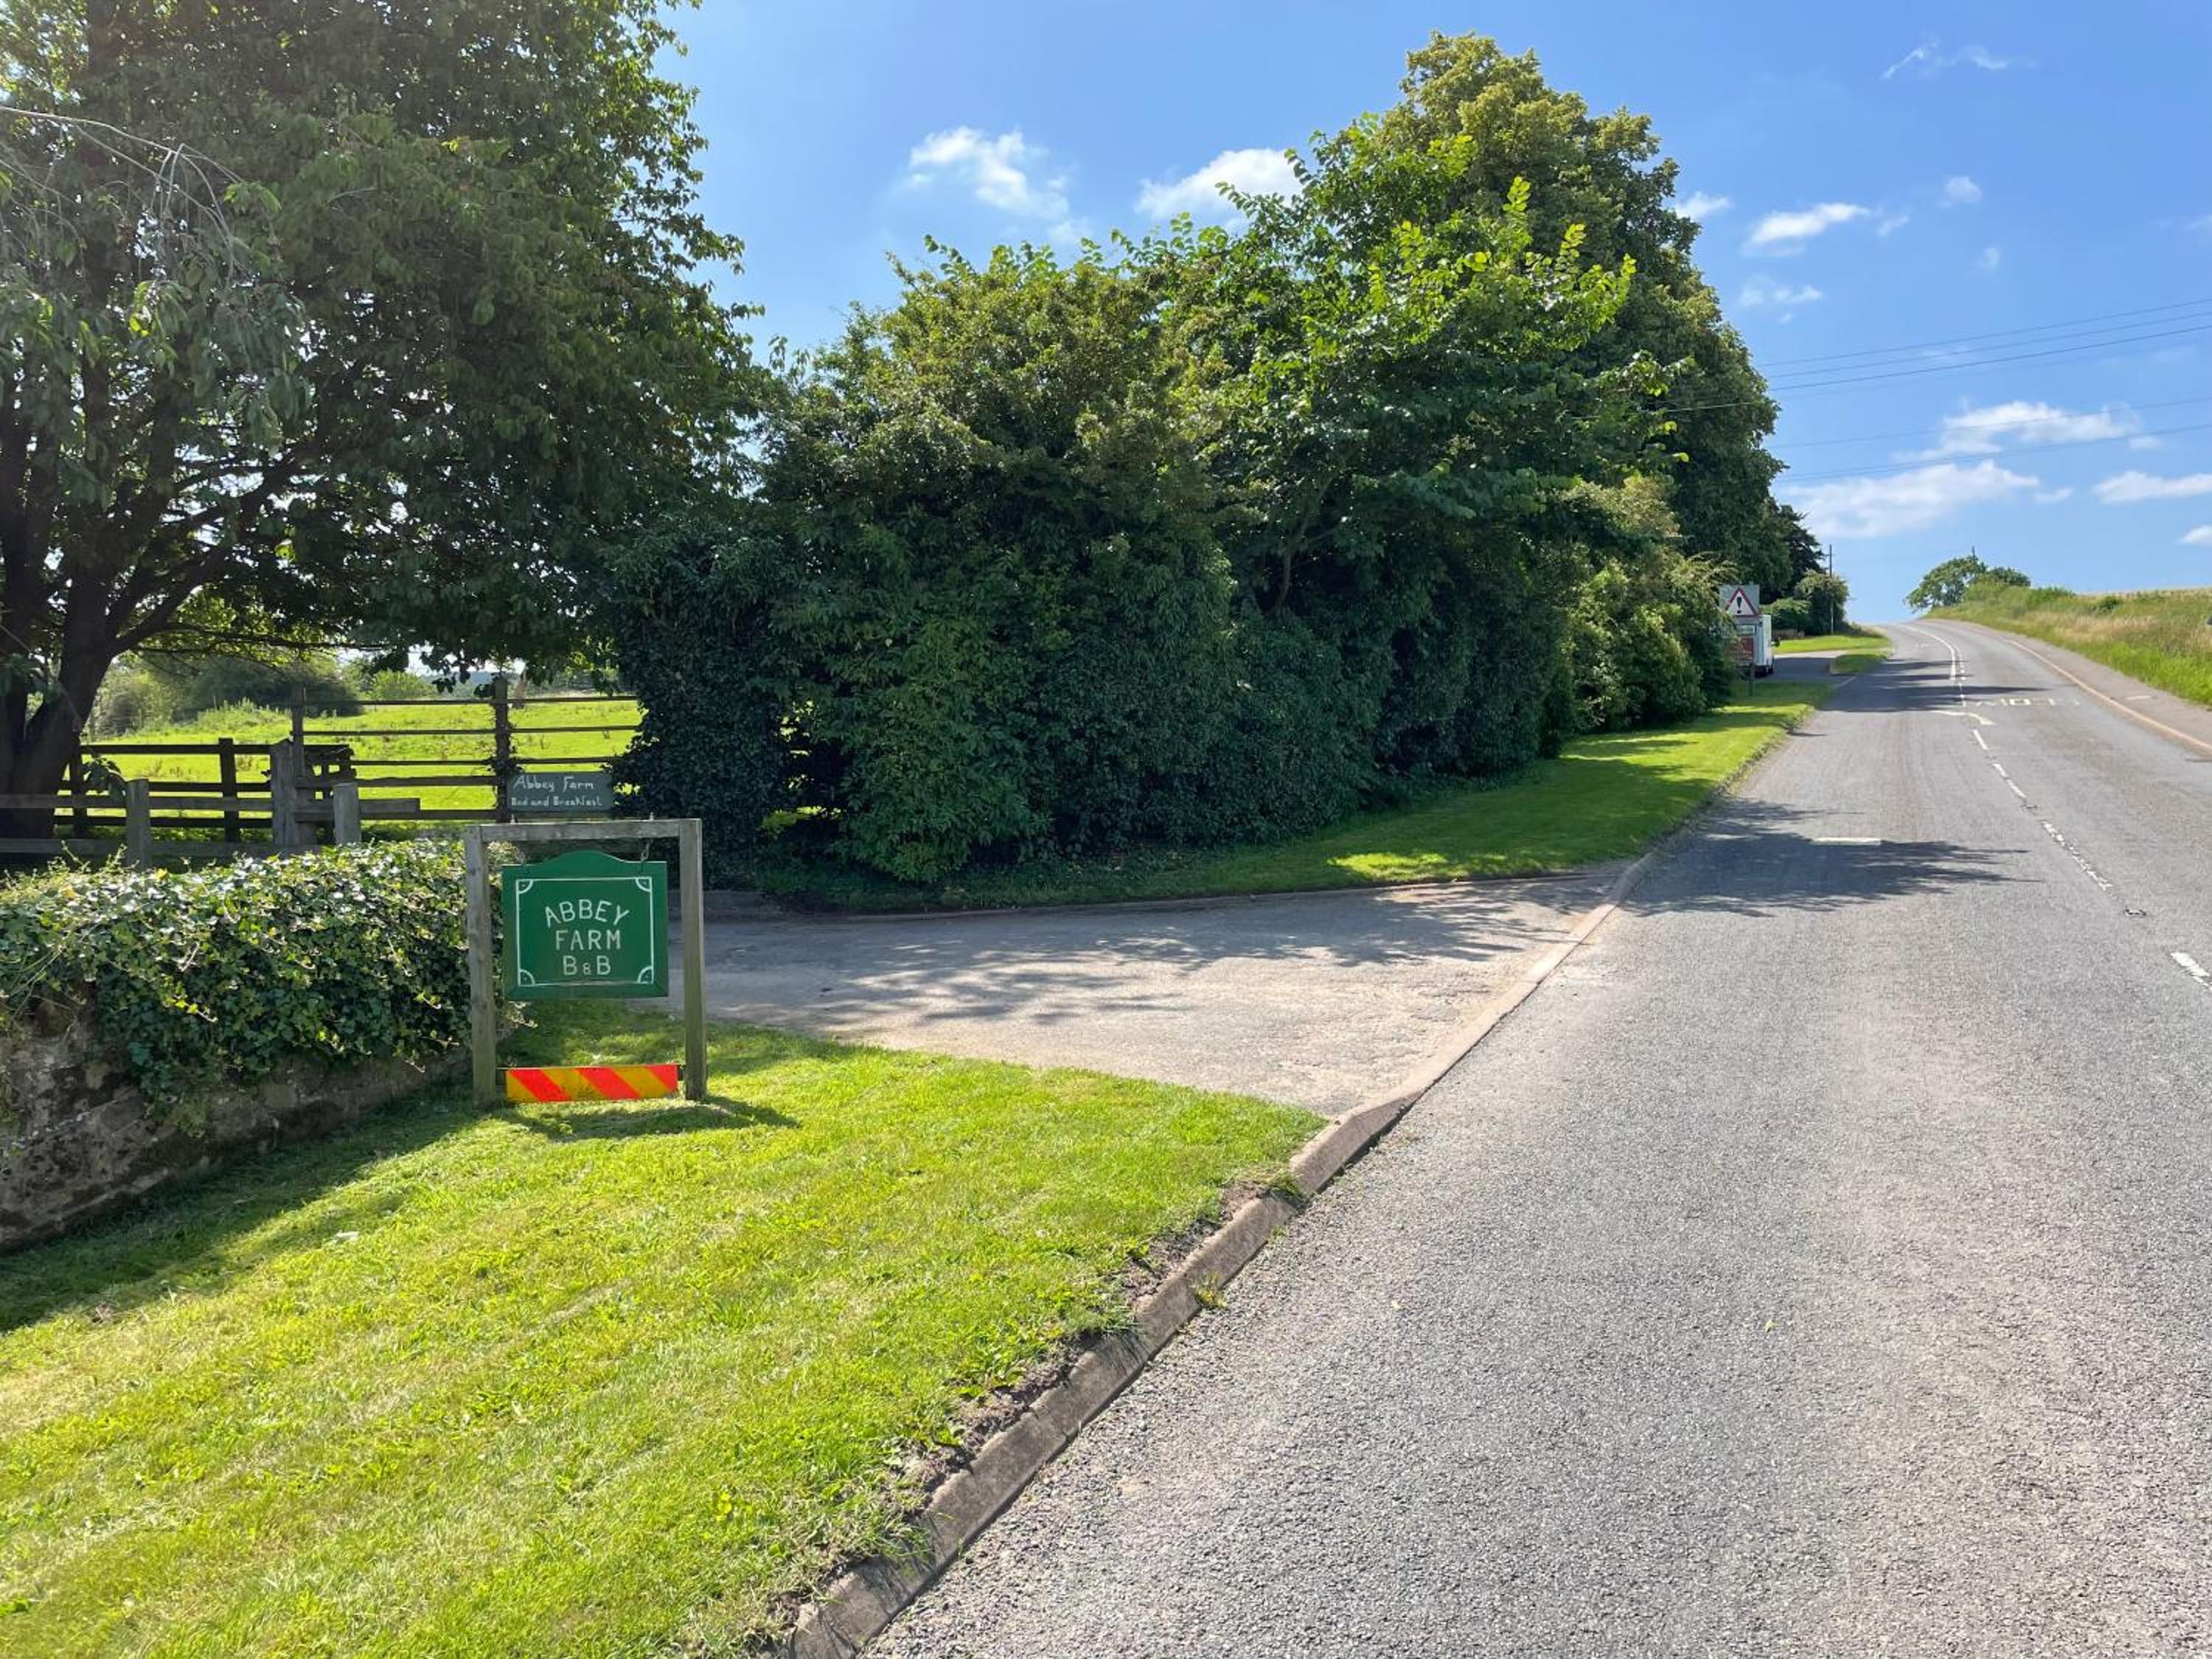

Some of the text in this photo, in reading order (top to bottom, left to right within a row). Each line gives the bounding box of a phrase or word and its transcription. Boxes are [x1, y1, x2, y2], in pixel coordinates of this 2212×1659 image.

[513, 775, 594, 793] Abbey Farm
[530, 796, 549, 806] and
[553, 796, 602, 806] Breakfast
[545, 899, 630, 928] ABBEY
[555, 929, 621, 950] FARM
